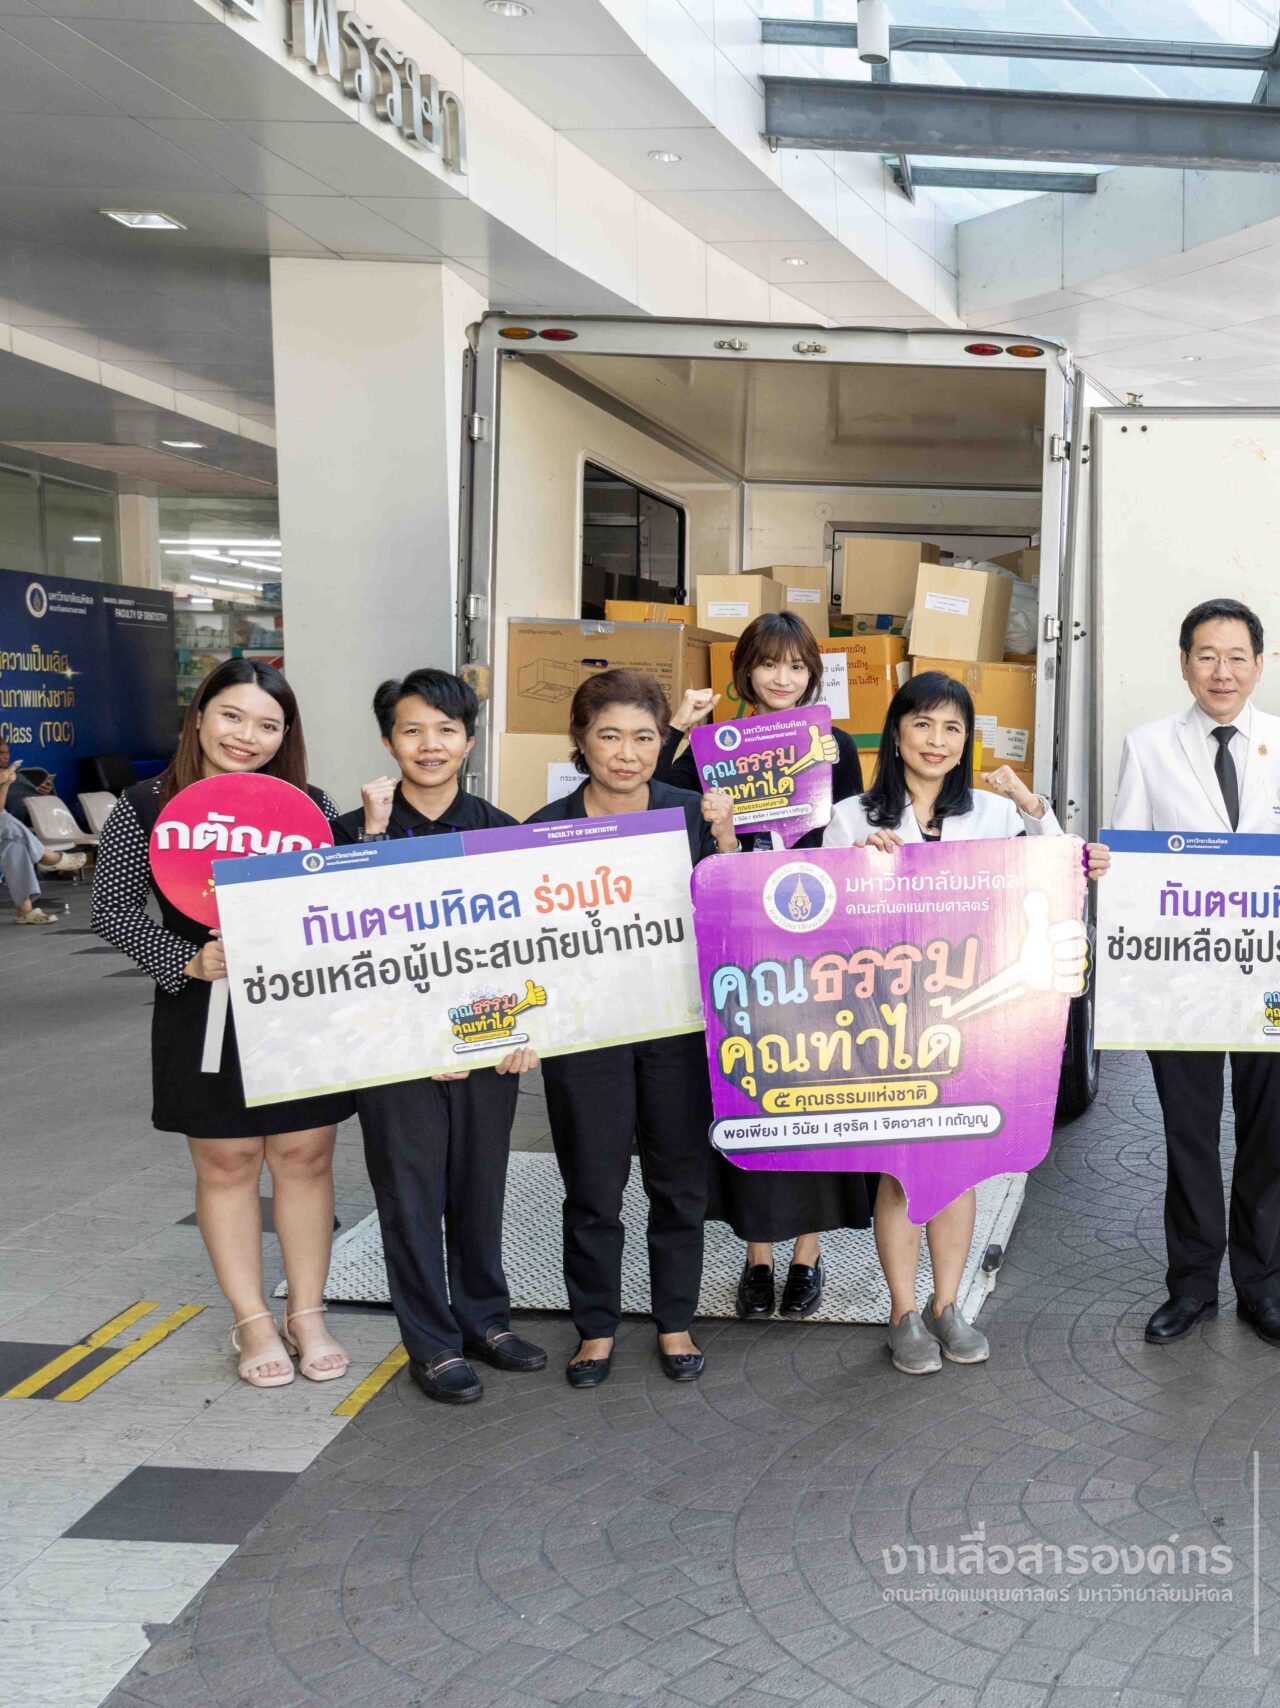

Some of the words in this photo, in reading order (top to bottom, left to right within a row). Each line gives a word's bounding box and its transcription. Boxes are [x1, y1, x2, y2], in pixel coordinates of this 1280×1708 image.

[115, 608, 137, 619] FACULTY
[39, 721, 76, 747] (TQC)
[743, 719, 808, 735] มหาวิทยาลัยมหิดล
[547, 830, 575, 839] FACULTY
[584, 825, 618, 835] DENTISTRY
[845, 870, 1021, 893] มหาวิทยาลัยมหิดล
[301, 888, 522, 946] ทันตฯมหิดล
[535, 865, 634, 915] ร่วมใจ
[845, 897, 990, 915] คณะทันตแพทยศาสตร์
[243, 906, 686, 1005] ช่วยเหลือผู้ประสบภัยน้ำท่วม
[712, 937, 979, 1034] คุณธรรม
[449, 993, 517, 1024] คุณธรรม
[452, 1008, 516, 1039] คุณทำได้
[720, 995, 963, 1097] คุณทำได้
[795, 1085, 928, 1111] คุณธรรมแห่งชาติ
[723, 1120, 778, 1140] พอเพียง
[792, 1118, 819, 1136] วินัย
[833, 1118, 869, 1138] สุจริต
[882, 1115, 934, 1130] จิตอาสา
[945, 1112, 989, 1128] กตัญญู
